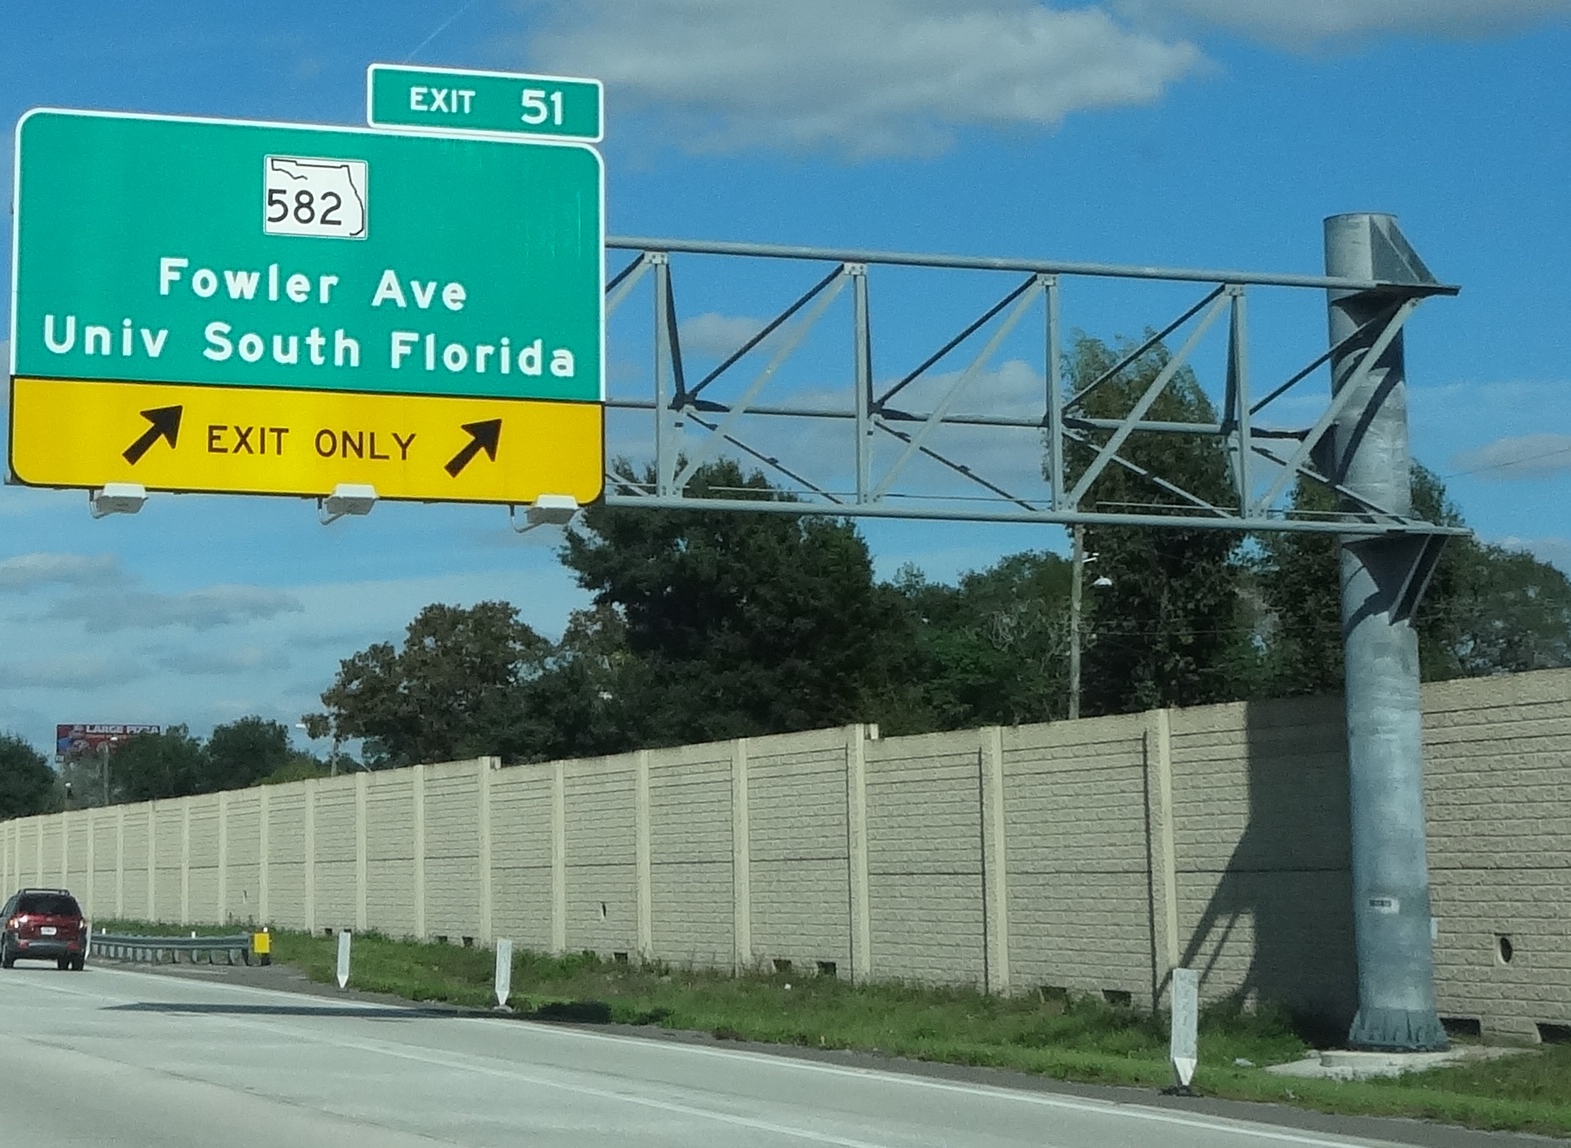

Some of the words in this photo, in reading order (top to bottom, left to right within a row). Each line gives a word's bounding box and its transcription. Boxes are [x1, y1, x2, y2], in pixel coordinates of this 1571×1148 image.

[408, 86, 476, 115] EXIT
[520, 89, 564, 126] 51
[266, 188, 343, 226] 582
[158, 257, 339, 304] Fowler
[371, 269, 468, 311] Ave
[43, 314, 169, 358] Univ
[203, 322, 361, 368] South
[391, 332, 576, 377] Florida
[206, 424, 290, 456] EXIT
[314, 429, 417, 460] ONLY
[85, 725, 124, 734] LARGE
